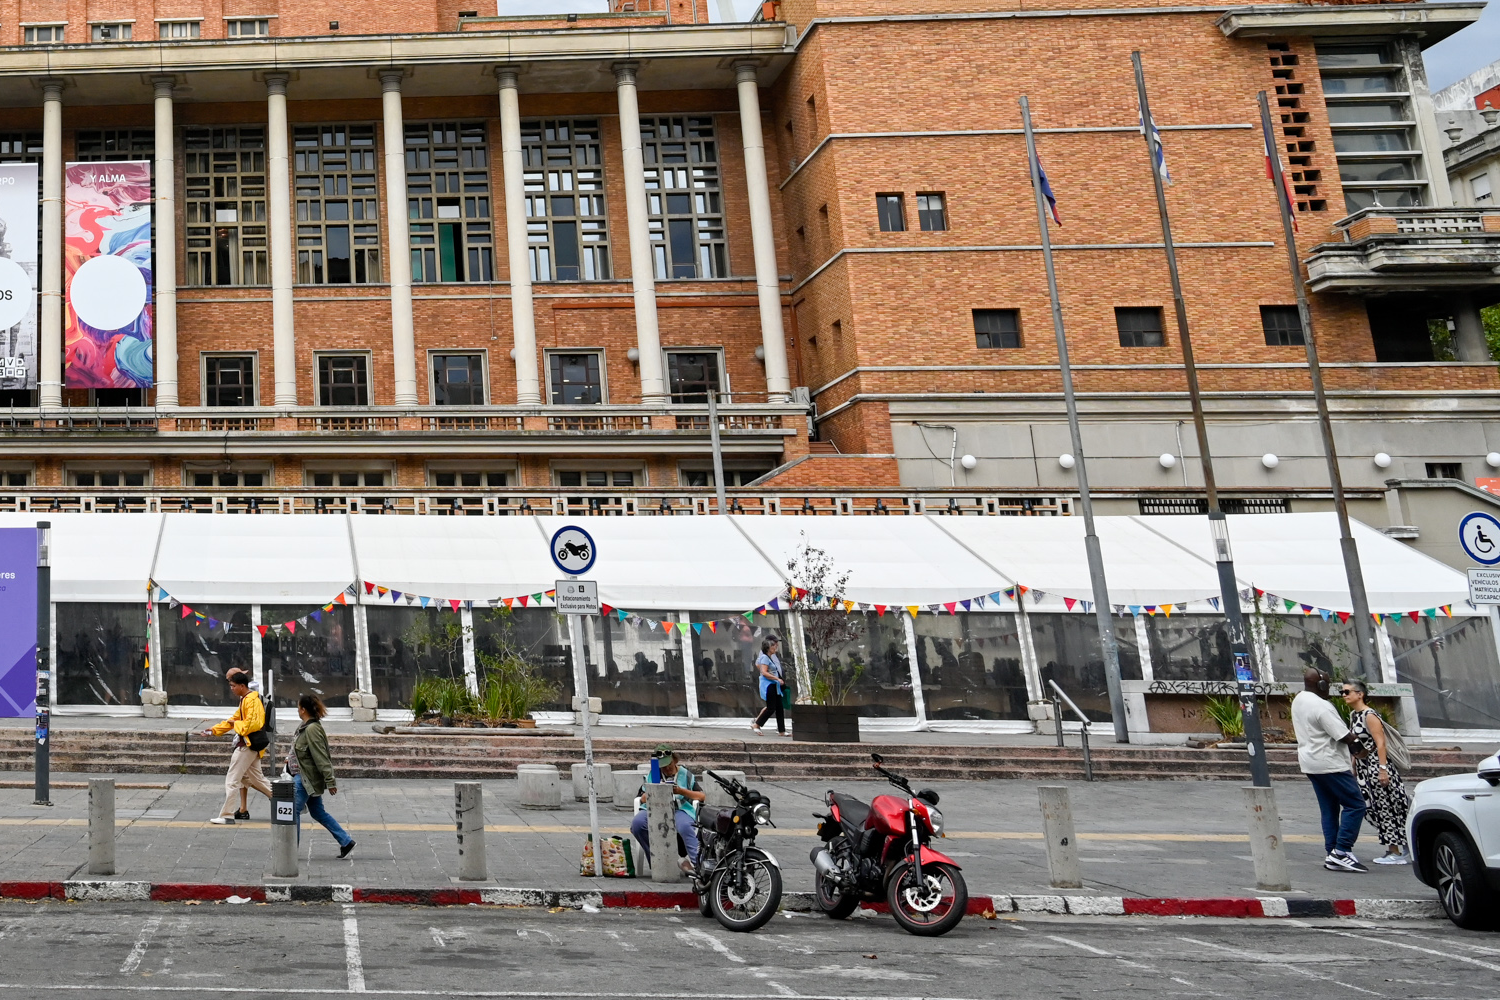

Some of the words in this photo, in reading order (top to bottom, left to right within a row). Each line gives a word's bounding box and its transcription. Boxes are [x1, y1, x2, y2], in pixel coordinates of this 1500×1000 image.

[90, 174, 97, 183] Y
[98, 173, 126, 183] ALMA
[278, 807, 293, 815] 622
